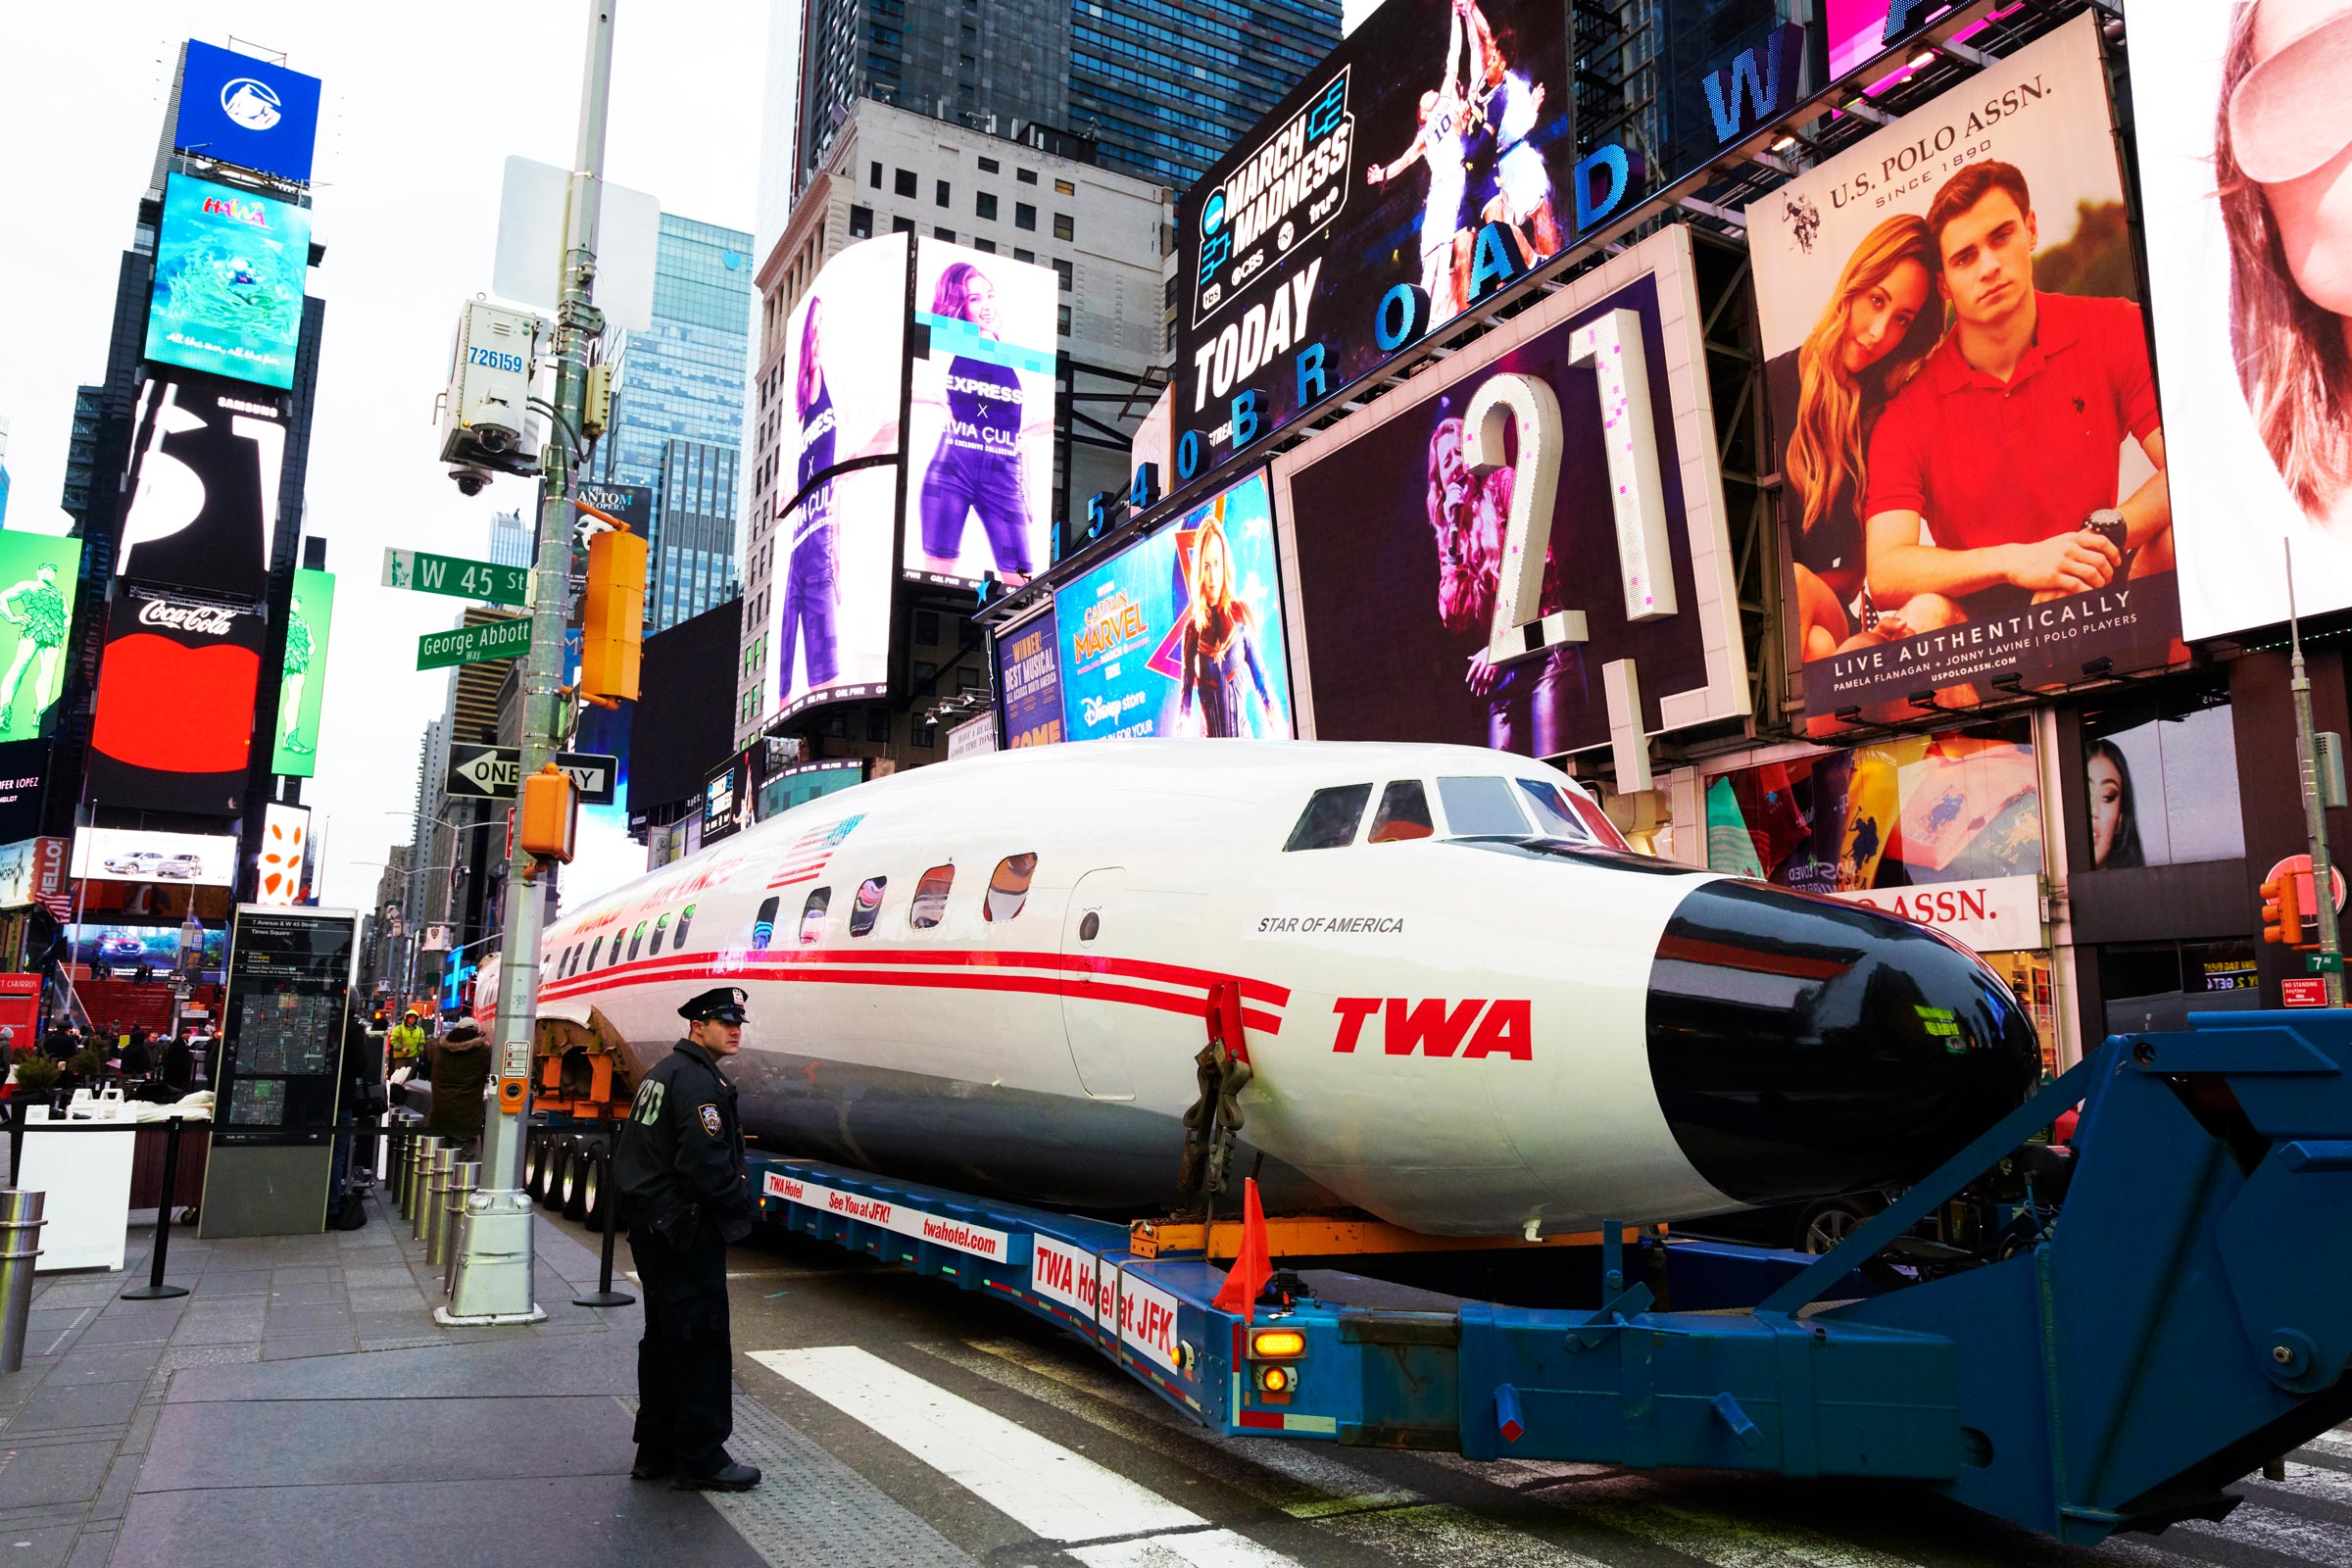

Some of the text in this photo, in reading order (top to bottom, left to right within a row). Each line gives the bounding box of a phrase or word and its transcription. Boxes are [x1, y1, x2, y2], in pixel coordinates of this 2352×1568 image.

[1434, 114, 1452, 142] 10
[1831, 74, 2053, 210] U.S. POLO ASSN.
[1225, 114, 1306, 224] MARCH
[1876, 139, 1991, 208] SINCE 1890
[1233, 122, 1348, 258] MADNESS
[1241, 249, 1264, 280] CBS
[1203, 287, 1220, 306] tbs
[1195, 257, 1322, 413] TODAY
[469, 347, 522, 373] 726159
[946, 374, 1023, 405] EXPRESS
[217, 397, 278, 418] SAMSUNG
[1461, 308, 1668, 665] 21
[596, 503, 625, 512] OPERA
[421, 559, 525, 596] W 45 St
[1084, 589, 1129, 627] CAPTAIN
[423, 622, 529, 656] George Abbott
[1012, 631, 1043, 663] WINNER!
[1073, 603, 1149, 664] MARVEL
[1835, 590, 2132, 678] LIVE AUTHENTICALLY
[466, 650, 482, 662] Way
[1834, 677, 1872, 692] PAMELA
[1875, 662, 1932, 684] FLANAGAN
[1946, 649, 1984, 666] JONNY
[1988, 638, 2032, 658] LAVINE
[2044, 628, 2079, 644] POLO
[2082, 613, 2138, 635] PLAYERS
[1004, 664, 1022, 693] BEST
[1024, 648, 1055, 683] MUSICAL
[1041, 671, 1057, 693] AMERICA
[1932, 656, 2017, 682] USPOLOASSN.COM
[1122, 691, 1146, 710] store
[1132, 719, 1152, 736] YOUR
[16, 777, 39, 789] LOPEZ
[474, 760, 519, 784] ONE
[1892, 888, 1997, 924] ASSN.
[1258, 917, 1404, 933] STAR OF AMERICA
[2313, 956, 2323, 970] 7
[1332, 997, 1533, 1061] TWA
[770, 1176, 803, 1200] TWA Hotel
[829, 1192, 892, 1224] See You at JFK!
[923, 1218, 997, 1254] twahotel.com
[1037, 1246, 1073, 1295] TWA
[1121, 1293, 1134, 1333] at
[1137, 1298, 1174, 1357] JFK
